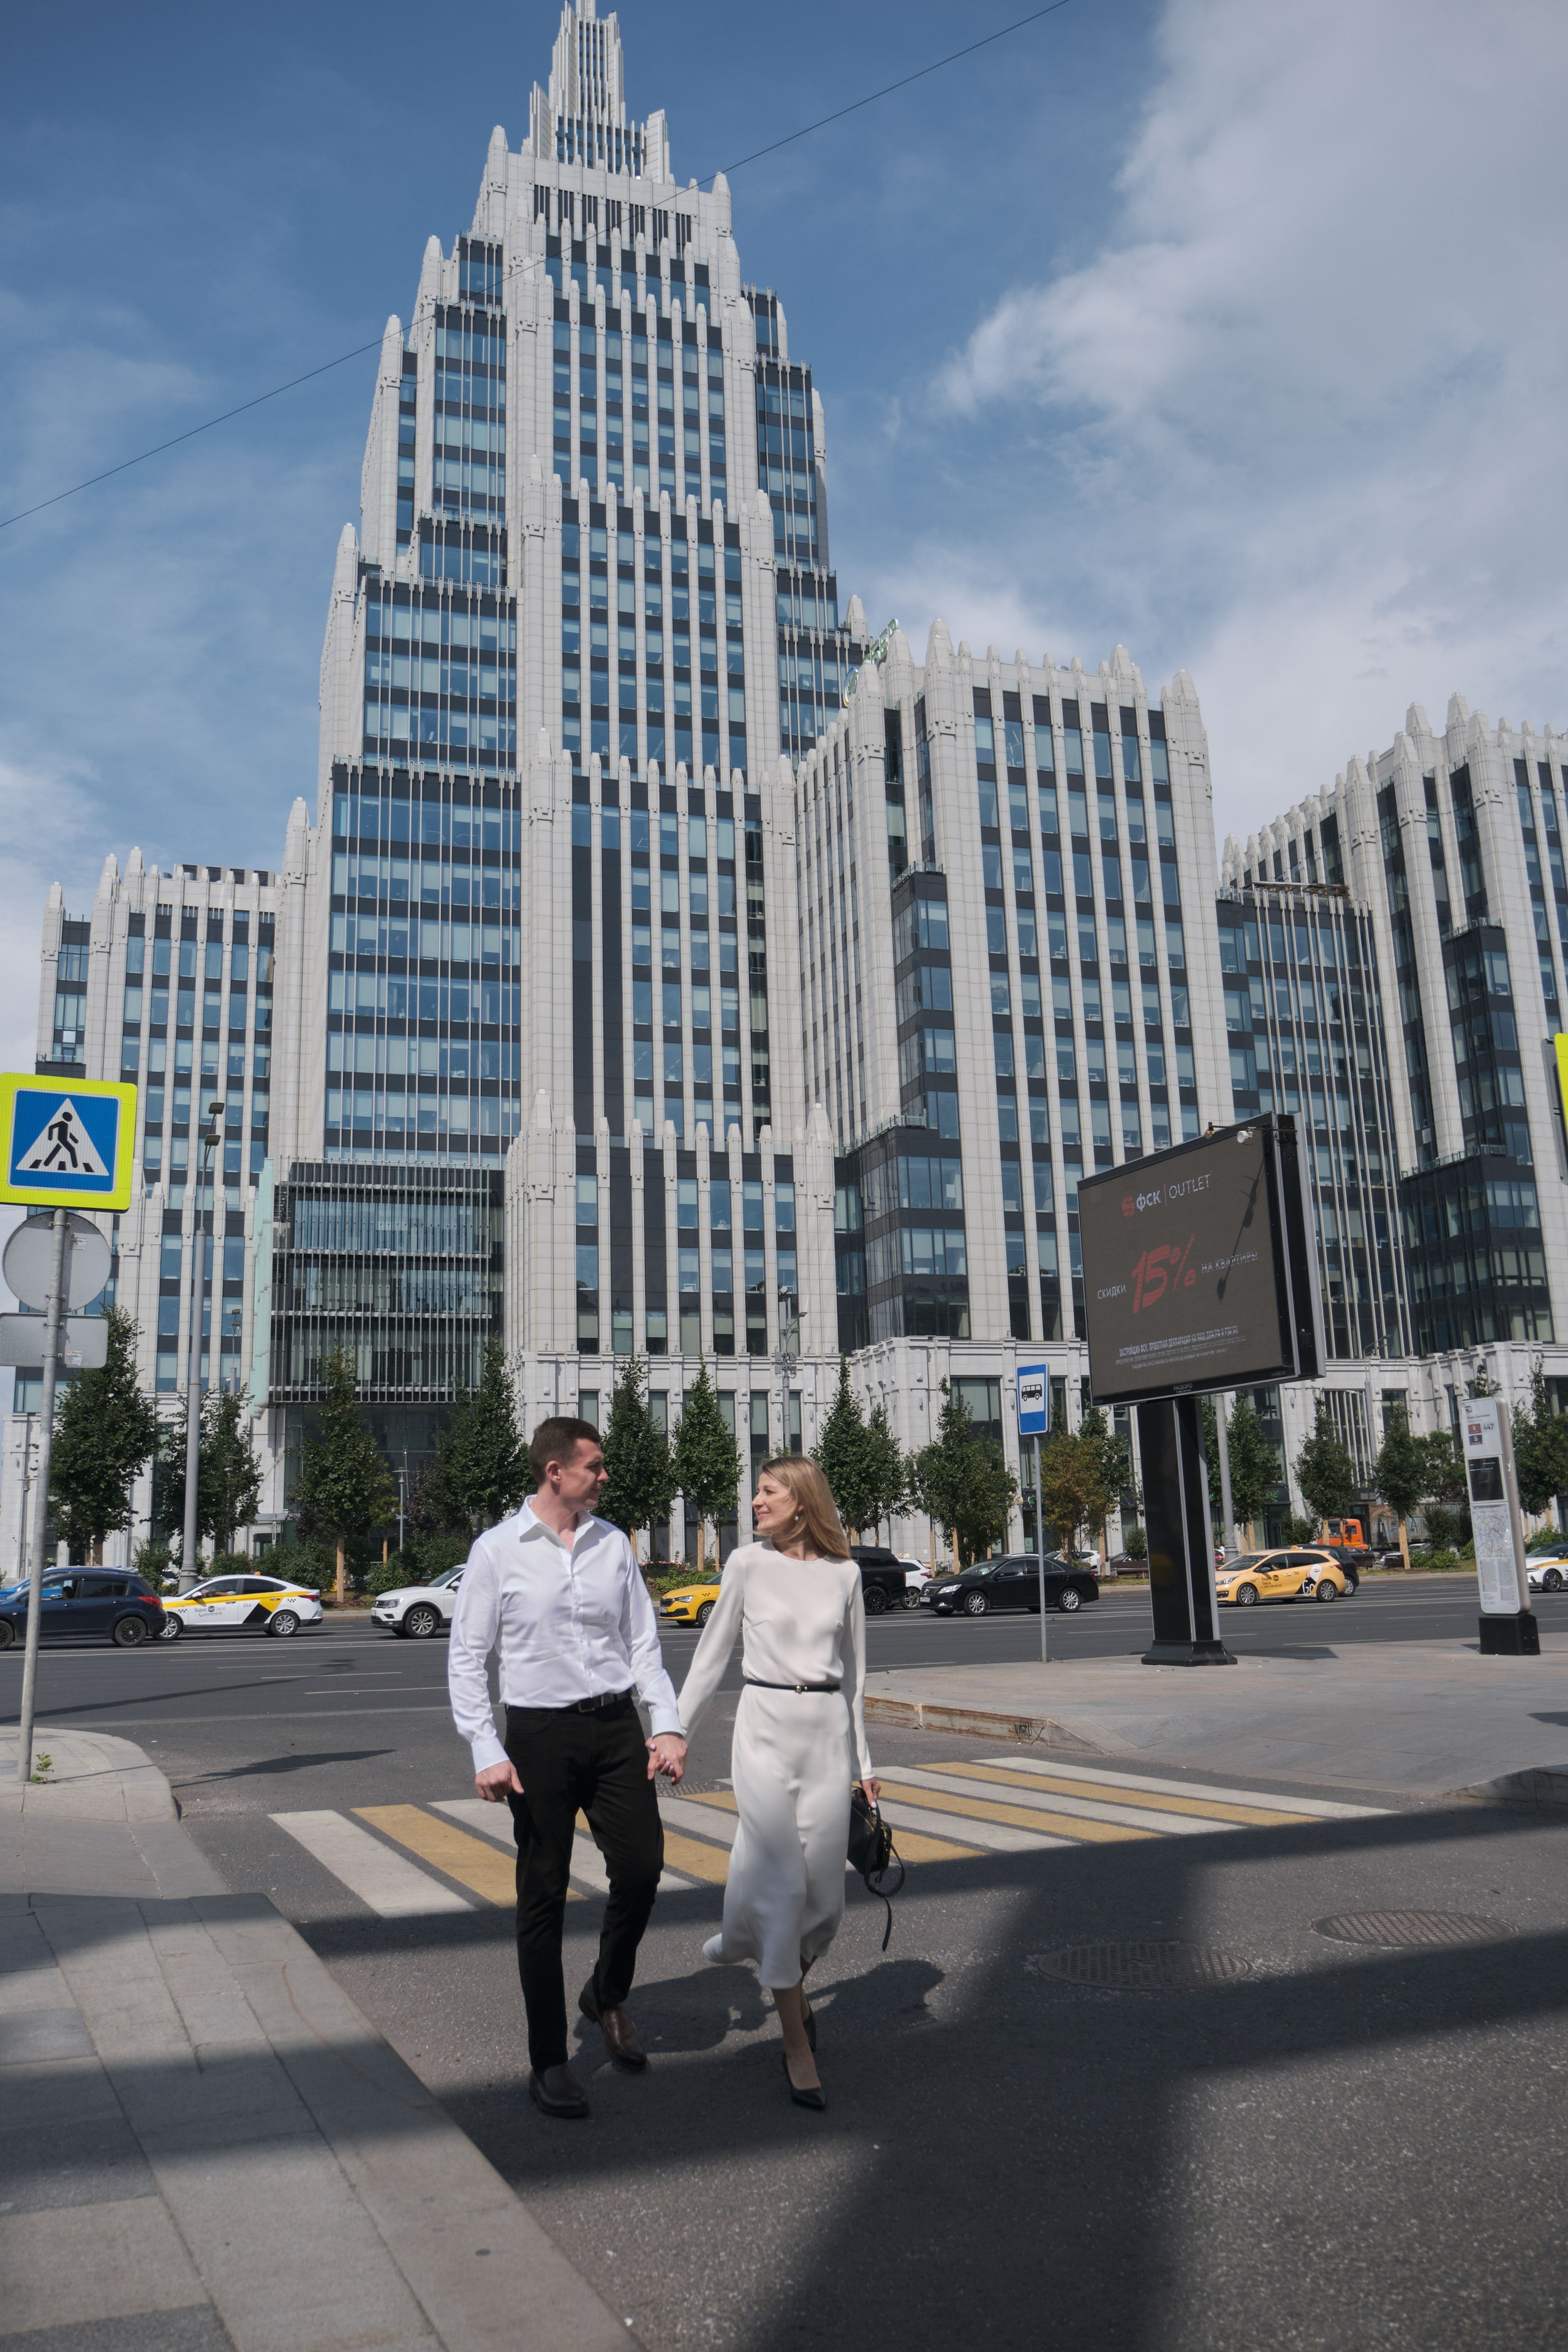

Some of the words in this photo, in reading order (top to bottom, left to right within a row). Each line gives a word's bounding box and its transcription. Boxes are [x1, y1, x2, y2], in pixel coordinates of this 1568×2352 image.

[1169, 1174, 1211, 1199] OUTLET
[1136, 1190, 1161, 1212] ФСК
[1098, 1284, 1126, 1299] СКИДКИ
[1131, 1234, 1197, 1314] 15%
[1202, 1262, 1214, 1273] НА
[1215, 1250, 1258, 1270] КВАРТИРЫ
